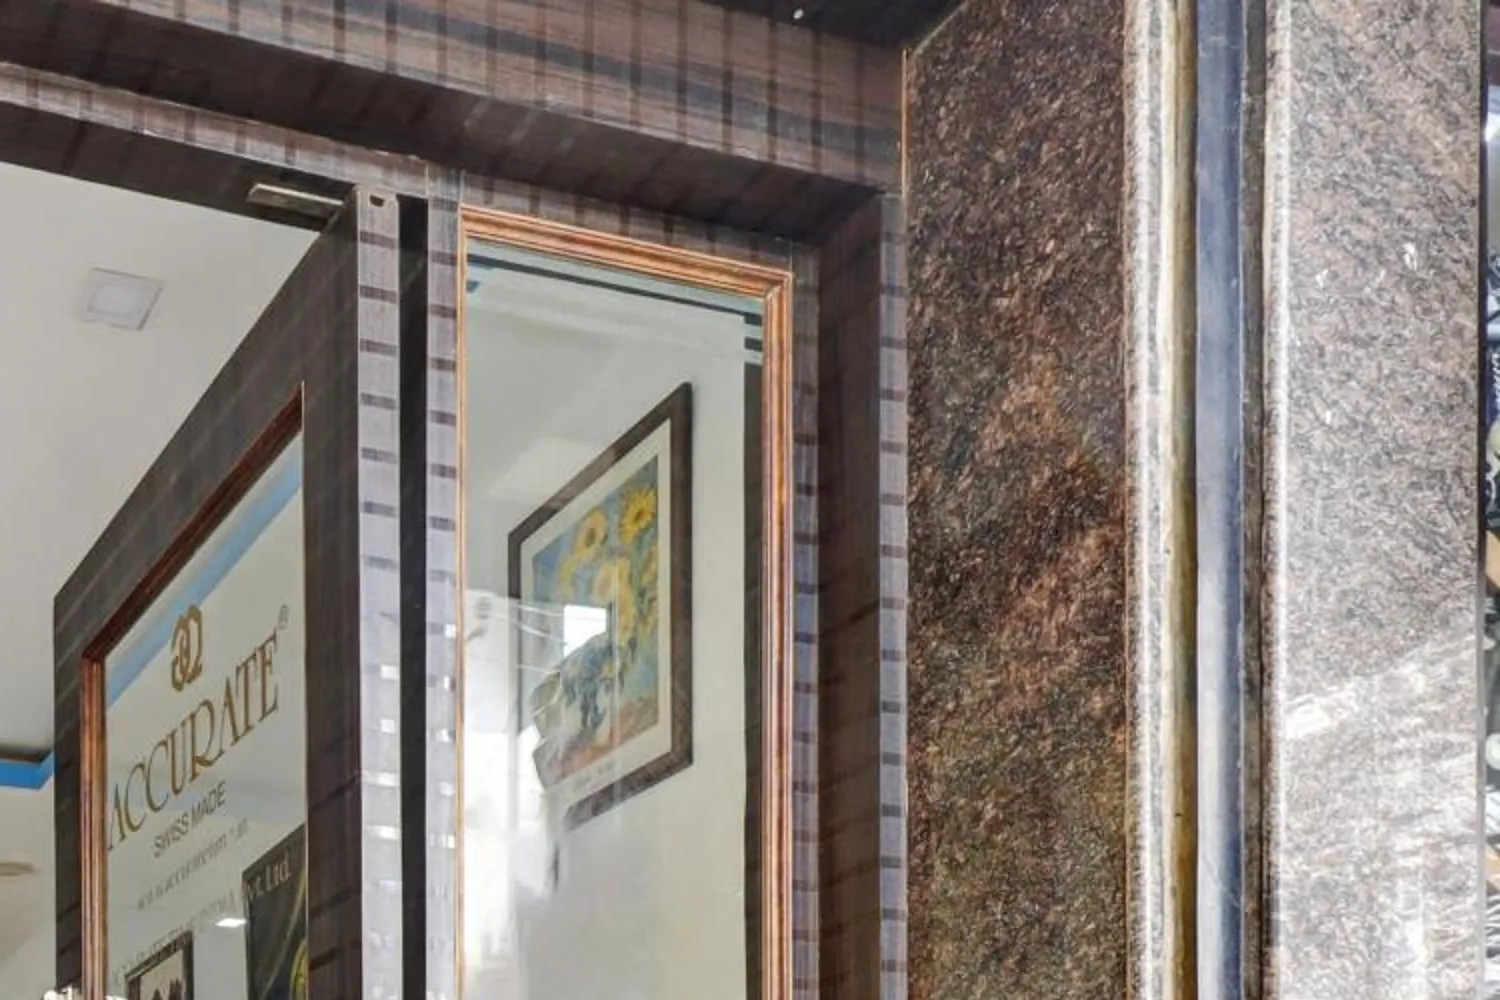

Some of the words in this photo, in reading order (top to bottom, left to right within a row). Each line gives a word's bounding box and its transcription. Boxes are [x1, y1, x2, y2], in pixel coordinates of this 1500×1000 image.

[108, 629, 279, 850] ACCURATE
[153, 811, 189, 858] SWISS
[191, 780, 226, 829] MADE
